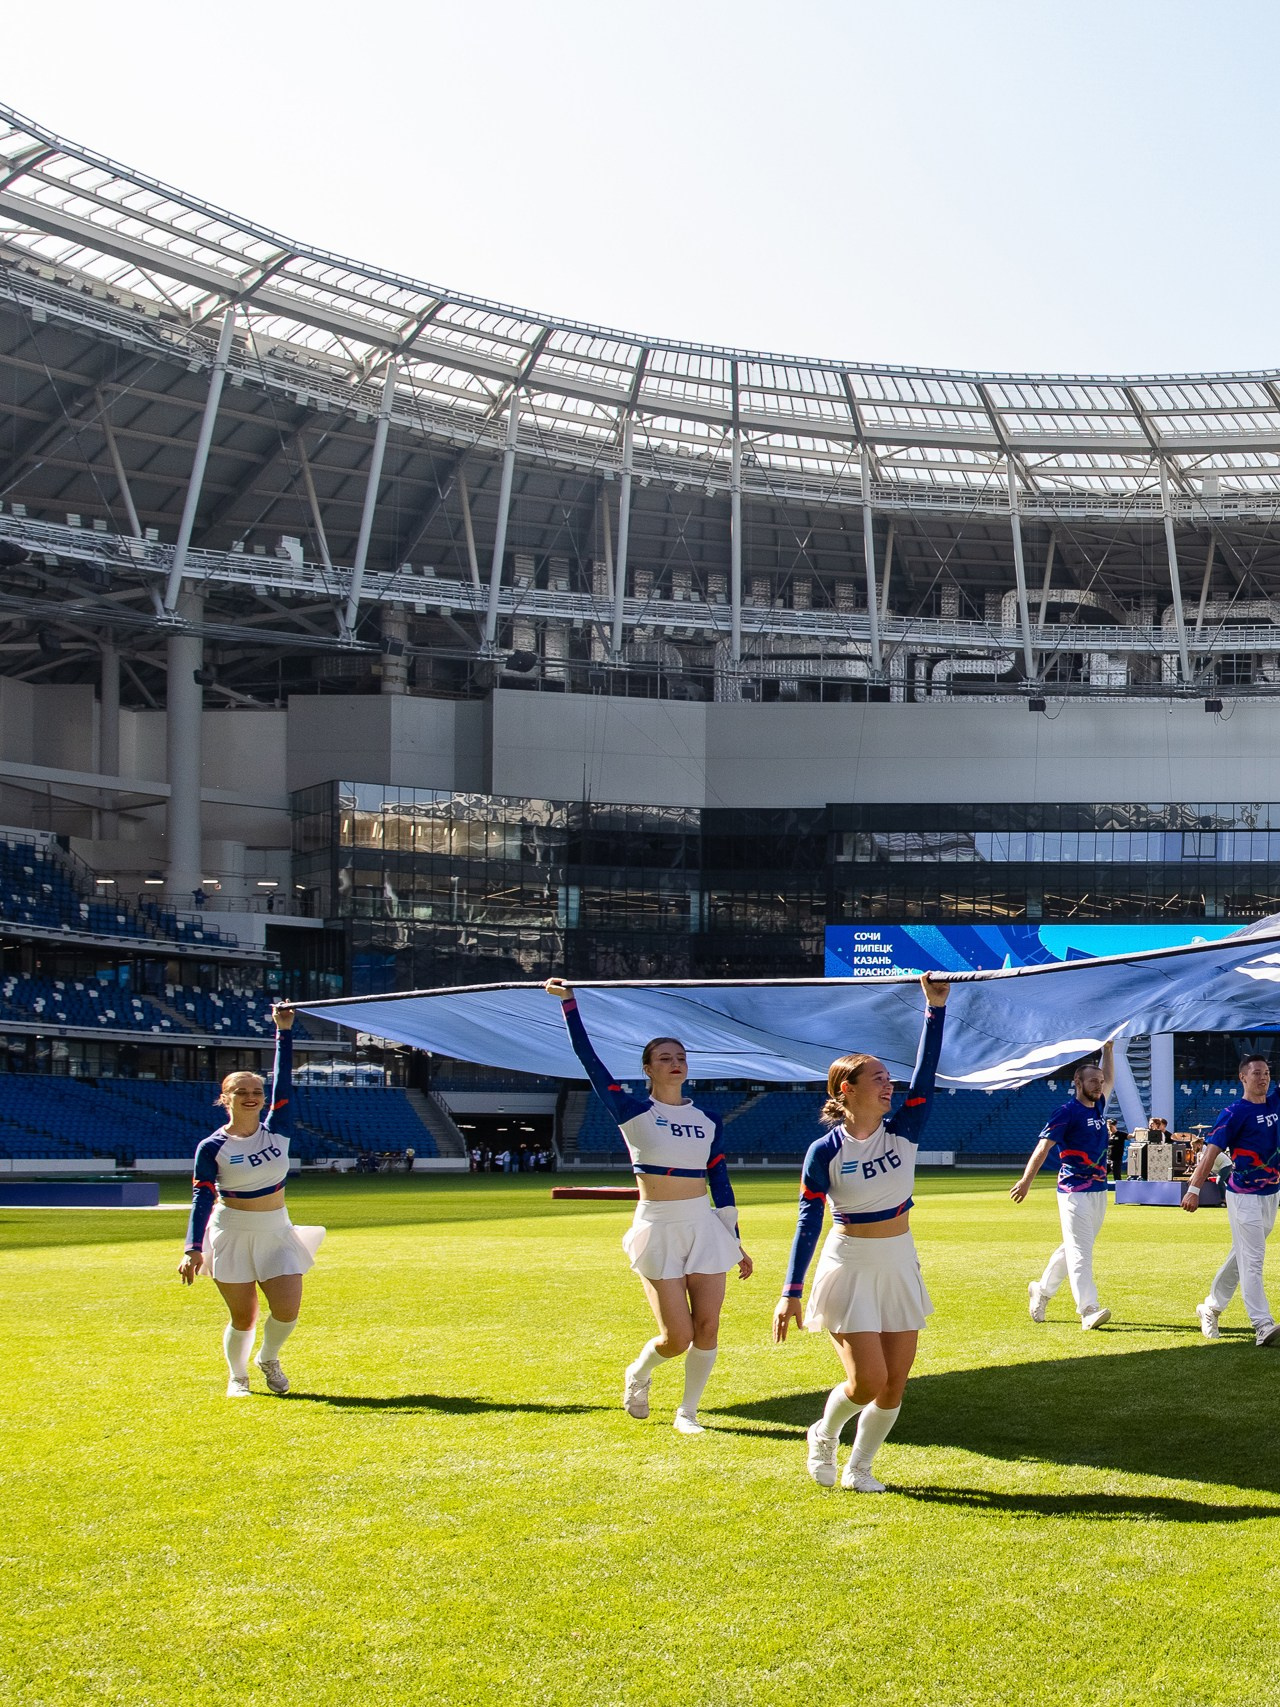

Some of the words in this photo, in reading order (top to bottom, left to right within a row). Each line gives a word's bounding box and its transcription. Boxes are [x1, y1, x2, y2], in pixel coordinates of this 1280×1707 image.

[853, 932, 881, 941] СОЧИ
[853, 944, 893, 954] ЛИПЕЦК
[853, 956, 892, 965] КАЗАНЬ
[853, 967, 915, 977] КРАСНОЯРСК
[670, 1123, 706, 1139] ВТБ
[247, 1144, 282, 1168] ВТБ
[861, 1148, 902, 1180] ВТБ
